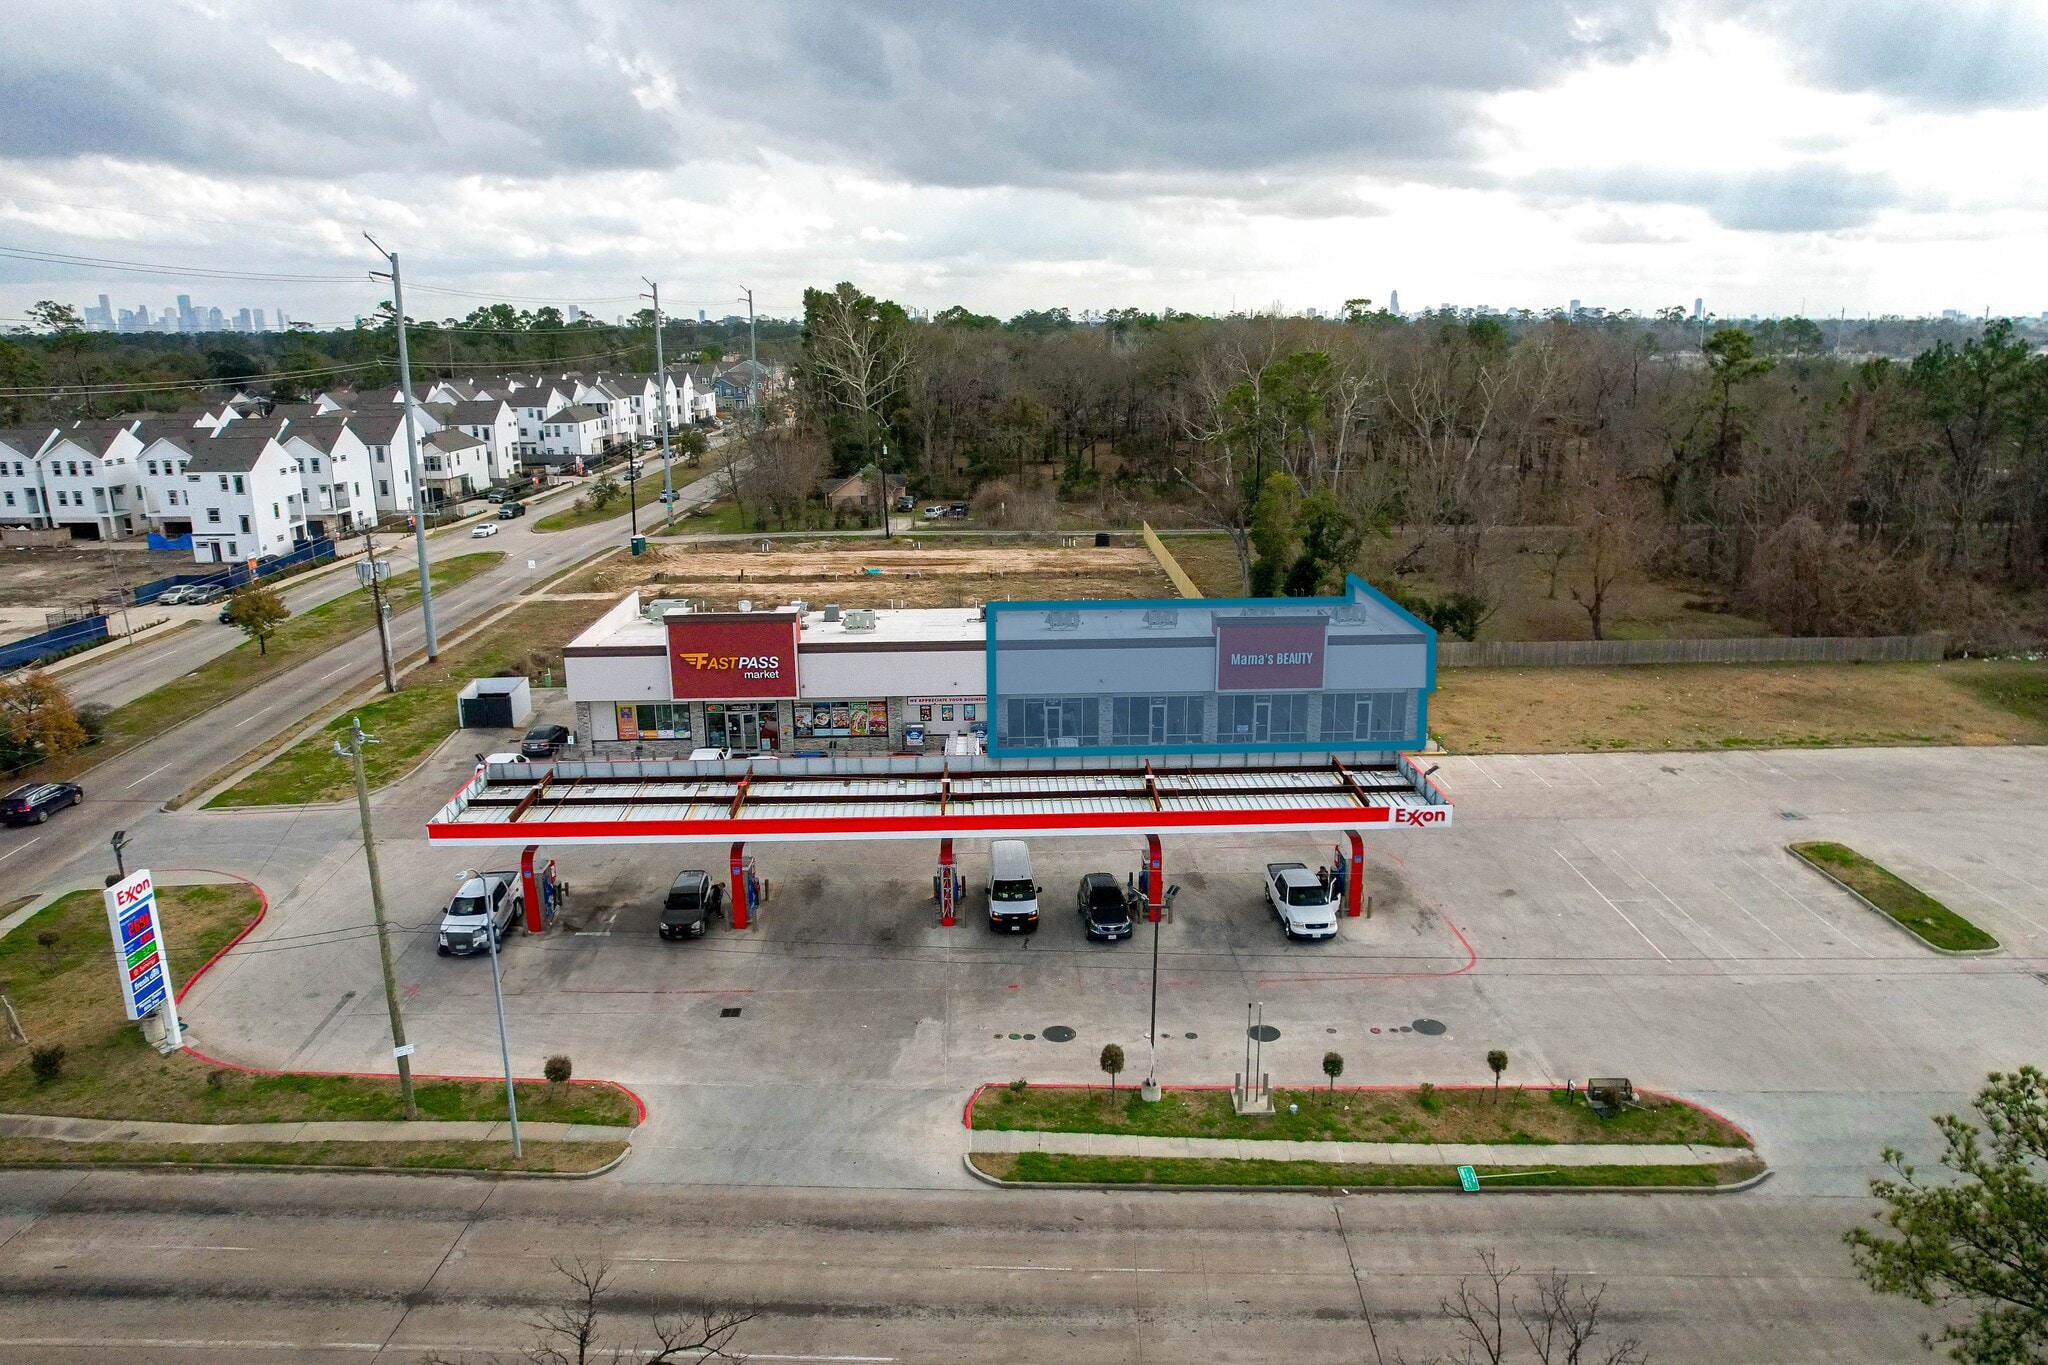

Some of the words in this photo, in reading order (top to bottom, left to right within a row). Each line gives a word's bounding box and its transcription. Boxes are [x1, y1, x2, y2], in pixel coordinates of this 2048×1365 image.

[1231, 652, 1274, 665] Mama's
[1276, 652, 1313, 665] BEAUTY
[744, 670, 779, 679] market
[1395, 808, 1446, 827] Exxon
[117, 878, 150, 906] Exxon
